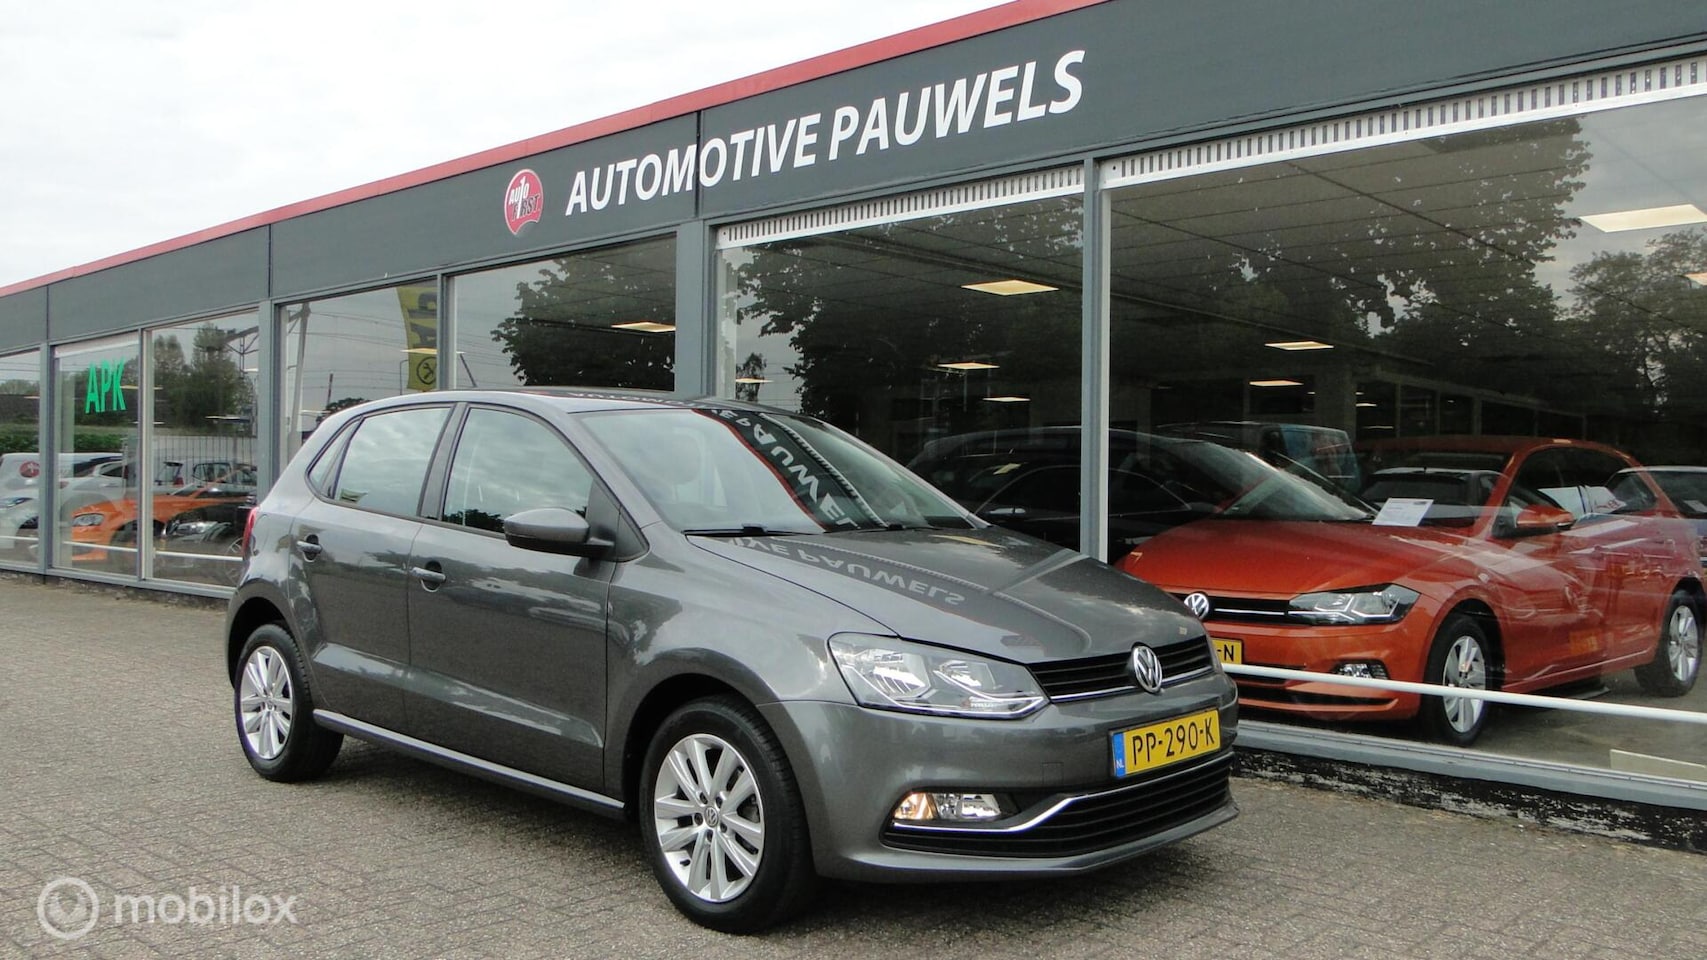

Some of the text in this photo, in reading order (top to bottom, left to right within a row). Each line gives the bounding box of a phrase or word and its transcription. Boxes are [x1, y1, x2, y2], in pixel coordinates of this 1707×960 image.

[565, 50, 1086, 216] AUTOMOTIVE PAUWELS
[85, 356, 127, 413] APK
[1115, 759, 1125, 769] NL
[1132, 717, 1215, 766] PP-290-K
